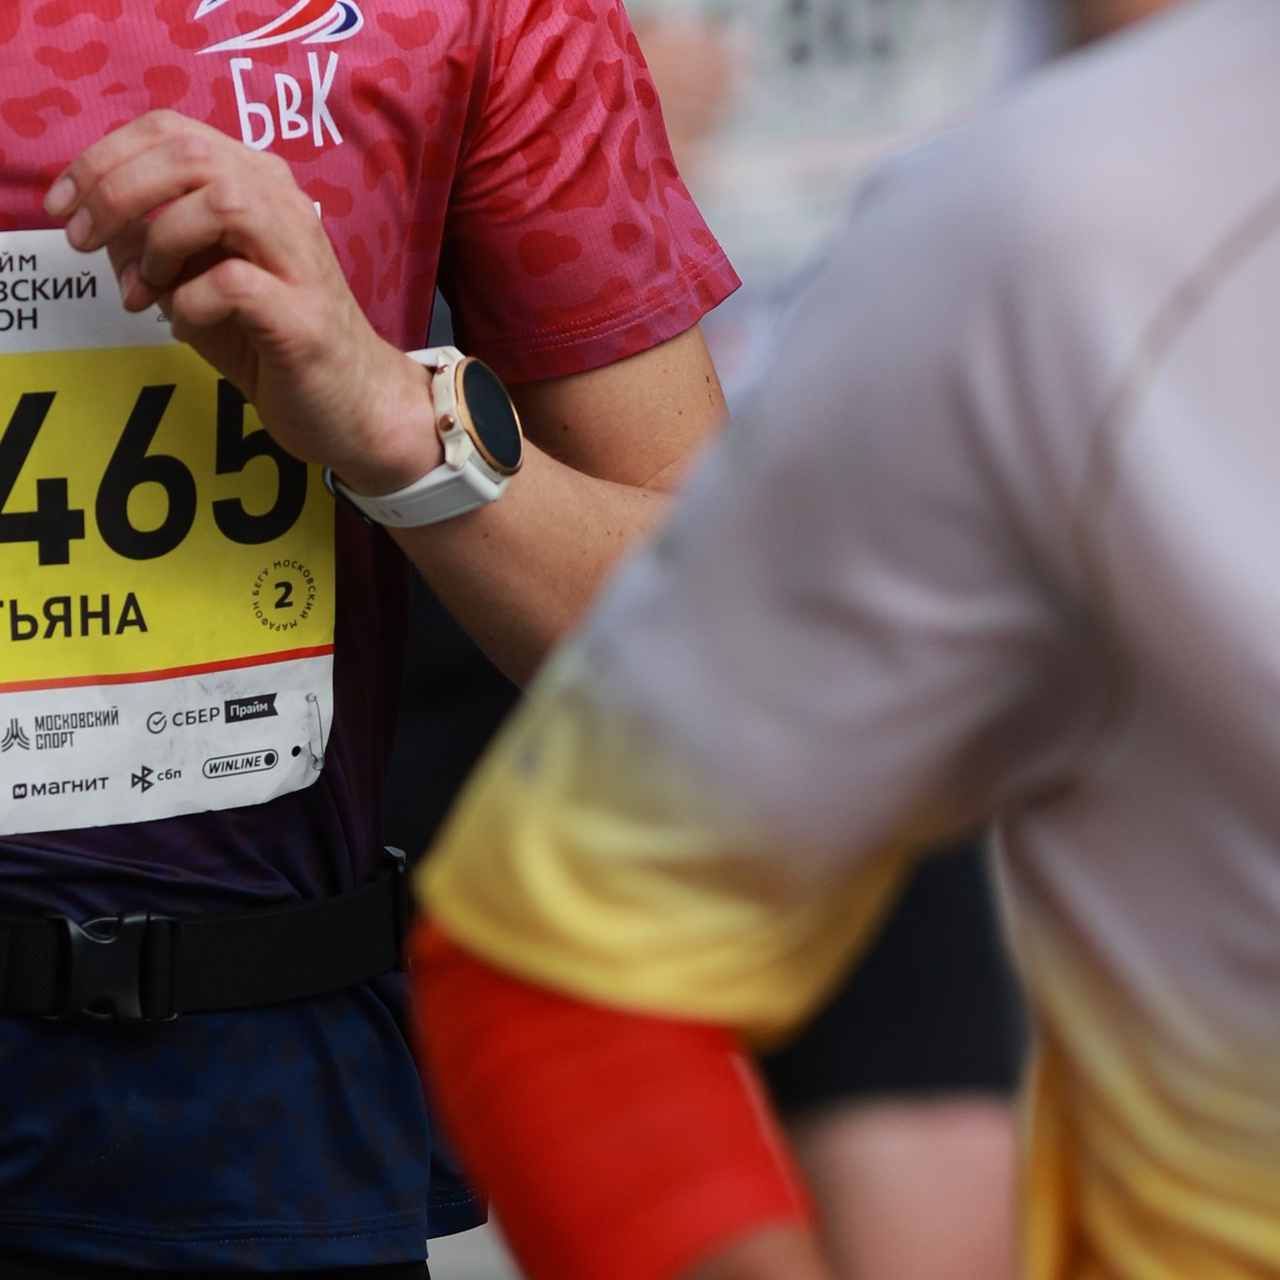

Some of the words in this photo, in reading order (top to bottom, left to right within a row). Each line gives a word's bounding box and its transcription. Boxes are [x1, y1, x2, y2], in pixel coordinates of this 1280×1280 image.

[274, 581, 294, 609] 2
[34, 705, 119, 732] МОСКОВСКИЙ
[172, 706, 220, 727] СБЕР
[229, 700, 269, 718] Прайм
[35, 731, 75, 750] СПОРТ
[157, 768, 182, 782] сбп
[207, 754, 262, 775] WINLINE
[31, 776, 109, 797] магнит
